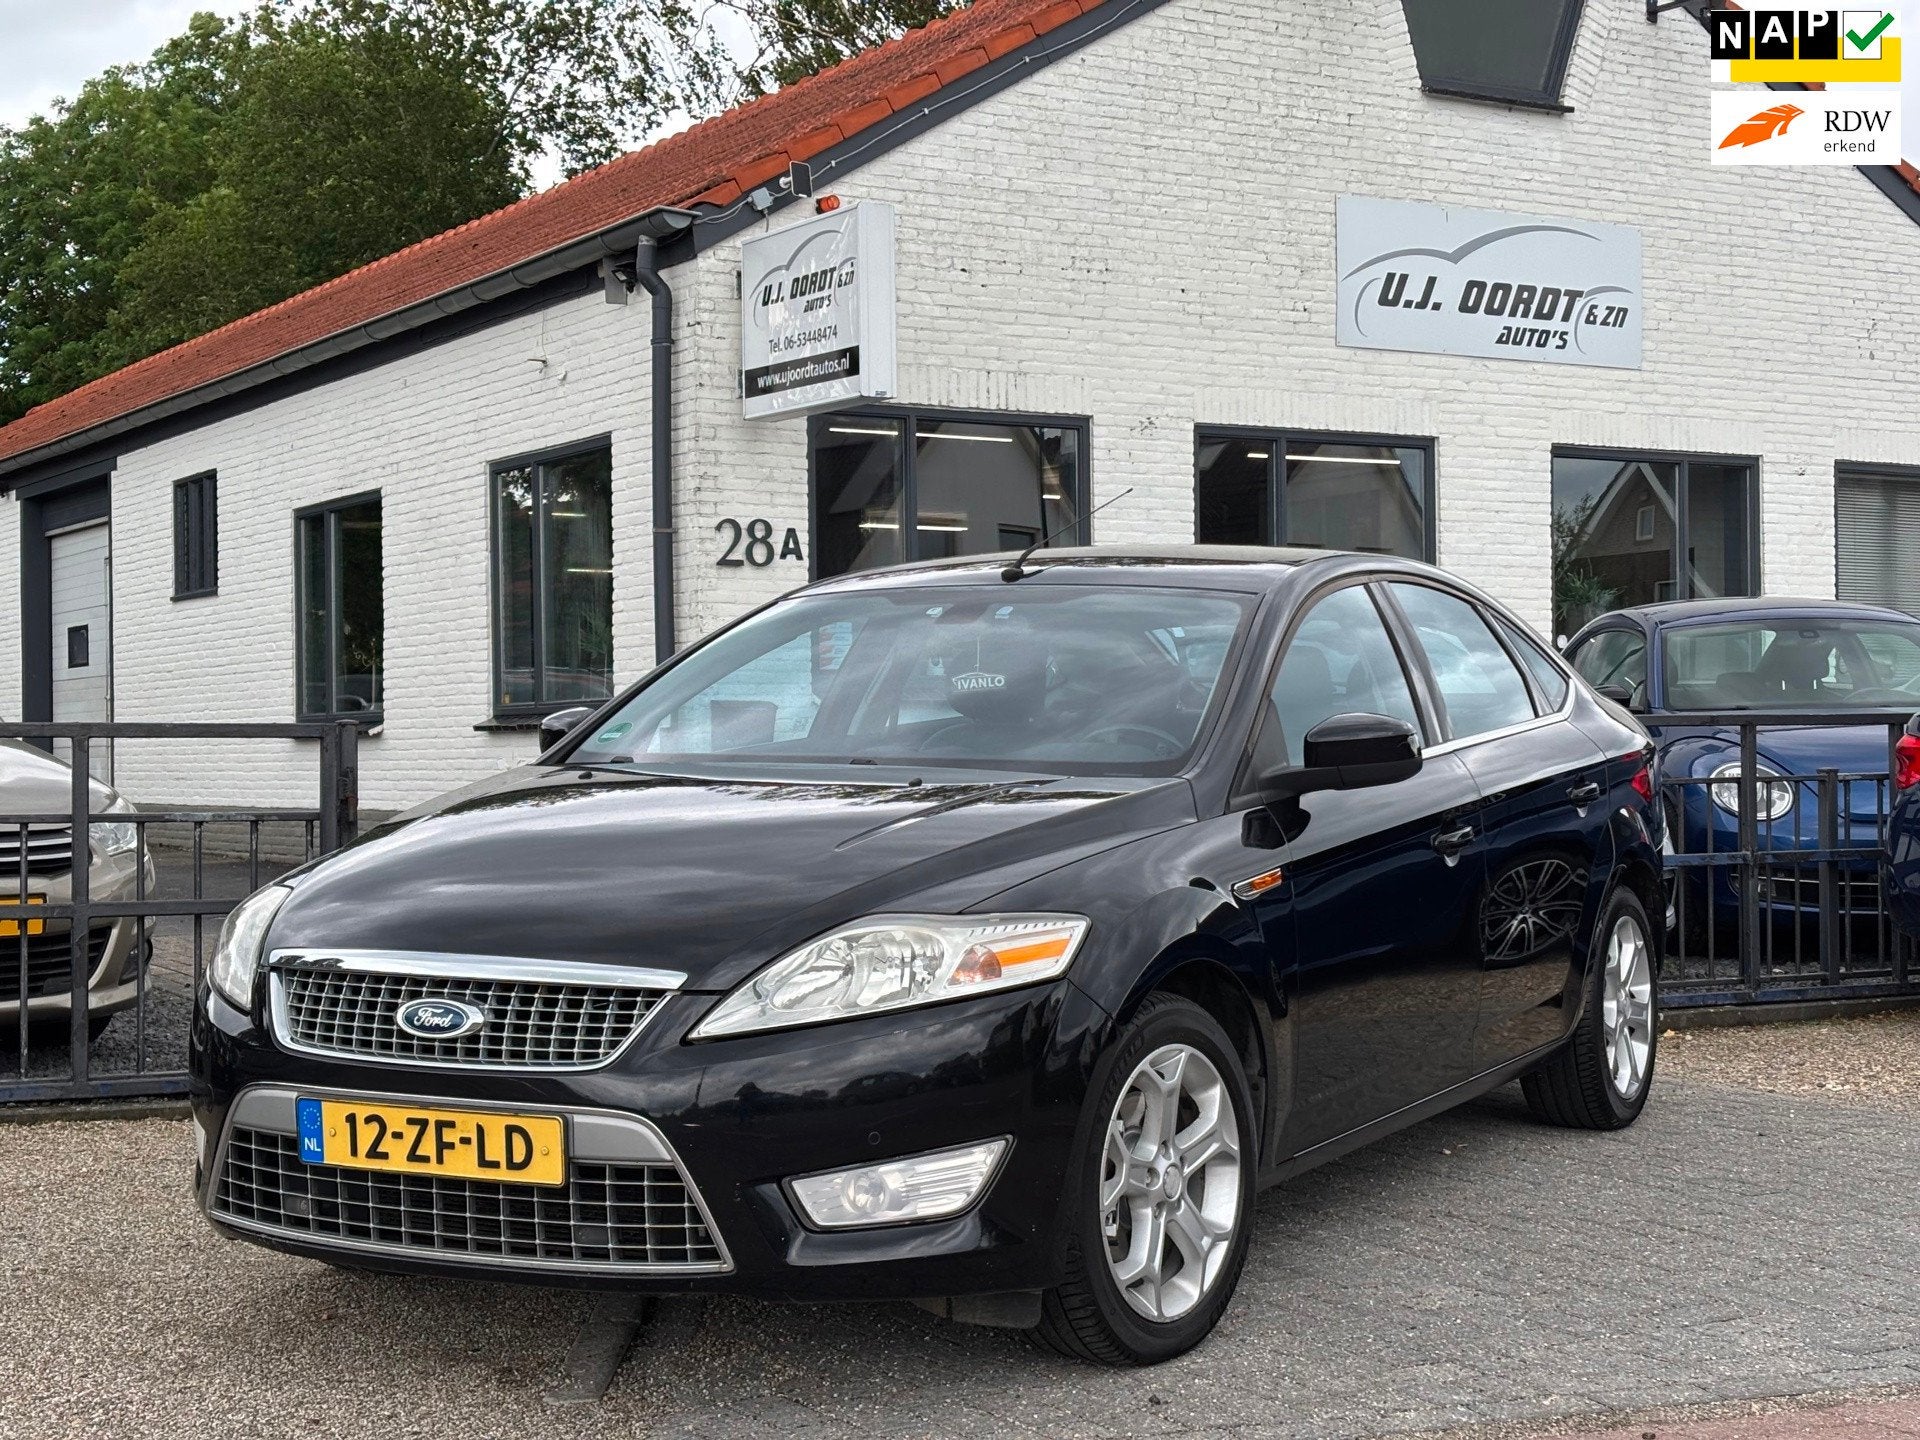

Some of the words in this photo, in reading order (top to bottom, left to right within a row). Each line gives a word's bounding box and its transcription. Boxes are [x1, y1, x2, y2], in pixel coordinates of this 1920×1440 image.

[762, 281, 785, 307] U.J.
[790, 266, 837, 299] OORDT
[1377, 272, 1443, 311] U.J.
[1458, 279, 1584, 323] OORDT
[769, 338, 783, 354] Tel.
[784, 324, 838, 350] 06-53448474
[1495, 325, 1569, 350] AUTO'S
[757, 352, 850, 388] www.ujoordtautos.nl
[957, 676, 1005, 690] IVANLO
[413, 1007, 454, 1028] Ford
[304, 1137, 321, 1152] NL
[345, 1112, 534, 1172] 12-ZF-LD
